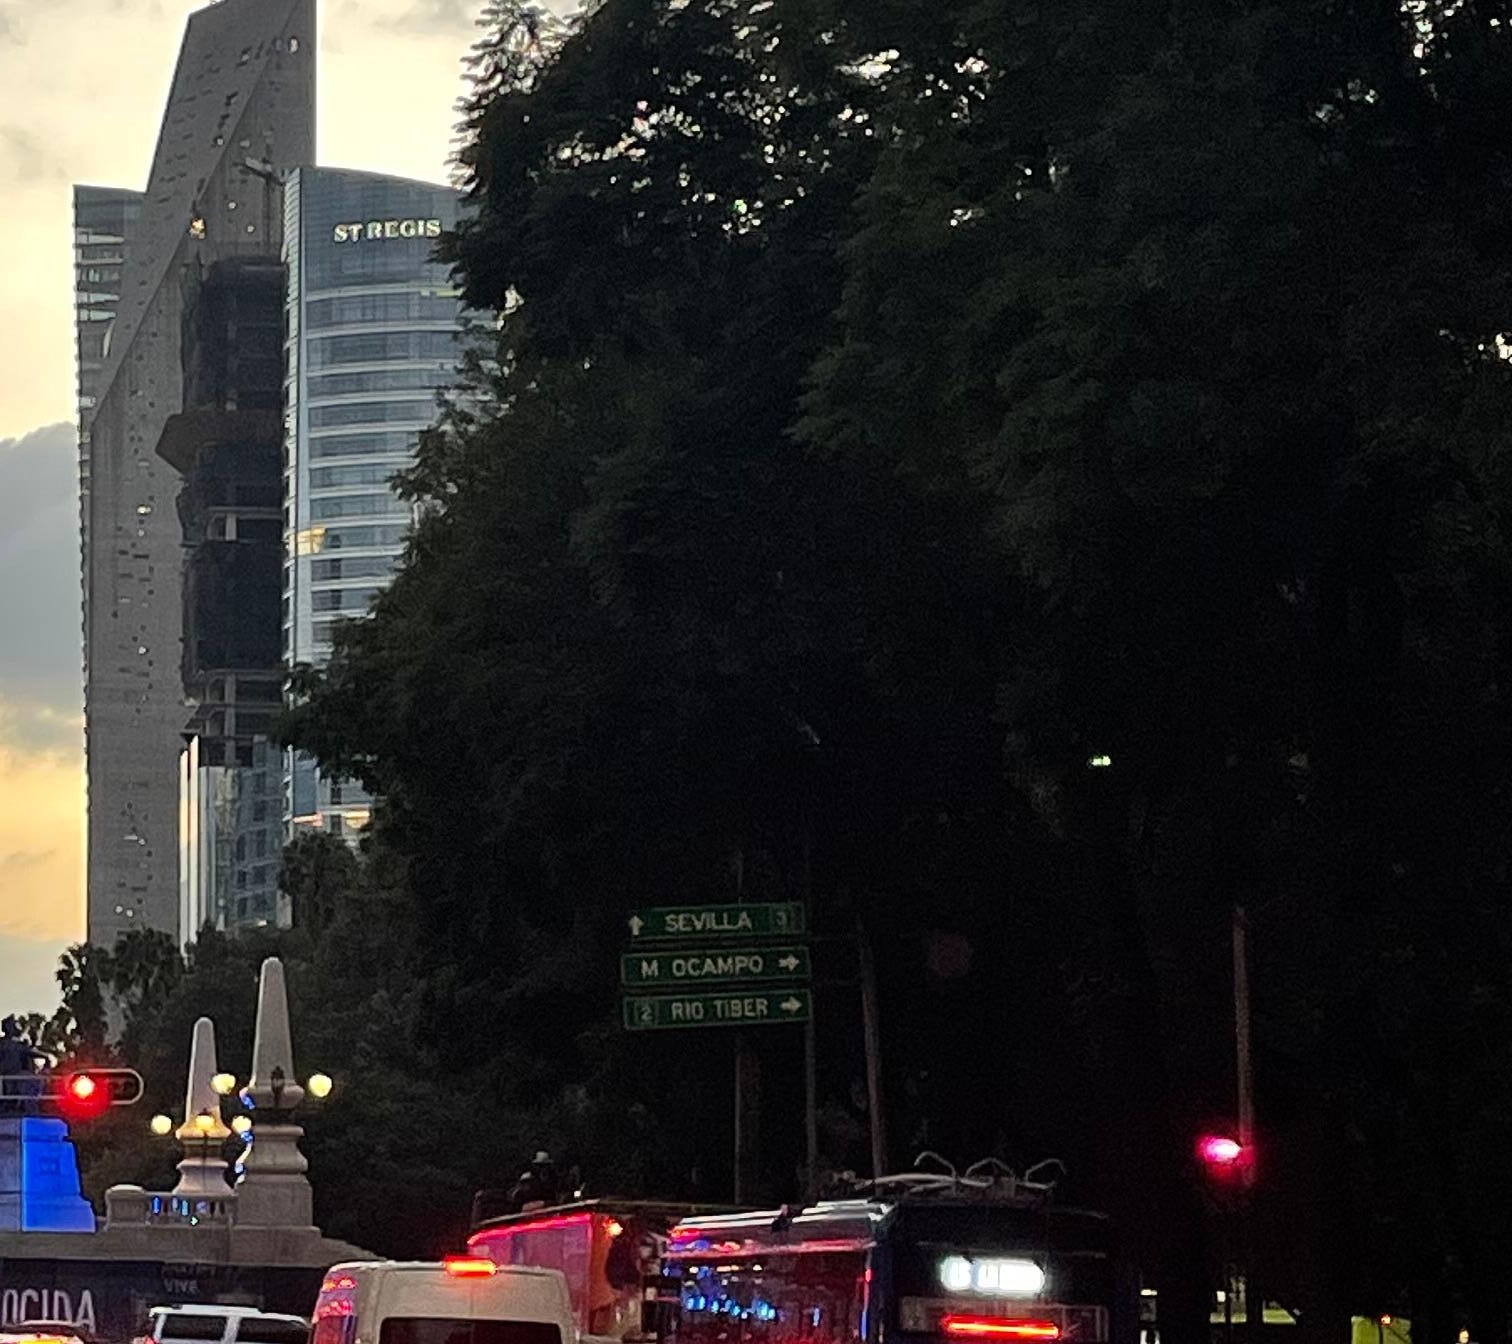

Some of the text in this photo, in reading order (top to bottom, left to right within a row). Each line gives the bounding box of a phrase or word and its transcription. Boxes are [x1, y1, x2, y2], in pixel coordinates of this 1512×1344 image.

[333, 218, 441, 243] ST REGIS
[664, 911, 753, 932] SEVILLA
[640, 955, 764, 978] M OCAMPO
